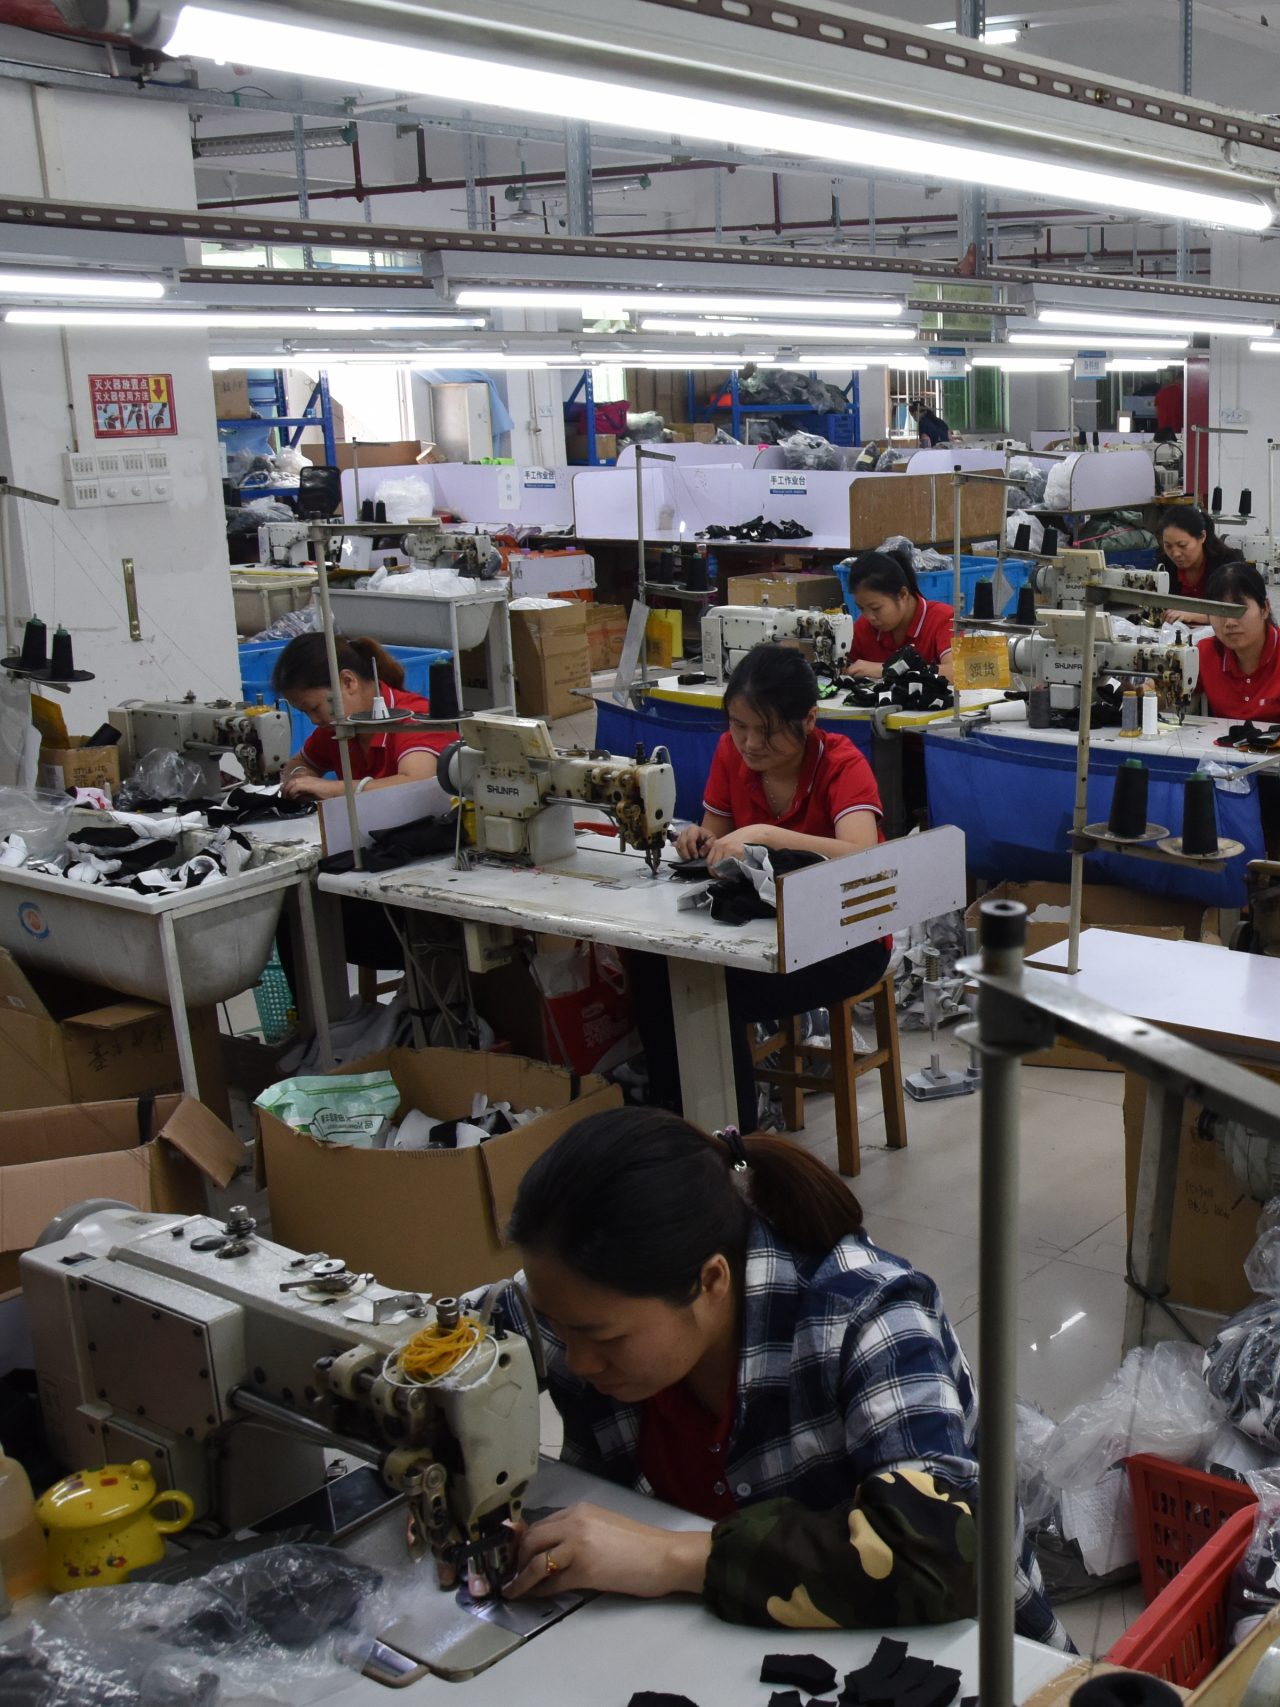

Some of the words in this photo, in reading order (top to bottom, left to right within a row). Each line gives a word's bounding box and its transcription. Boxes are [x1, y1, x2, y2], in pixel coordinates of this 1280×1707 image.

[95, 378, 149, 391] 灭火器放置点
[95, 391, 150, 402] 灭火器使用方法
[770, 475, 806, 486] 手工作业台
[486, 784, 520, 797] SHUNFA
